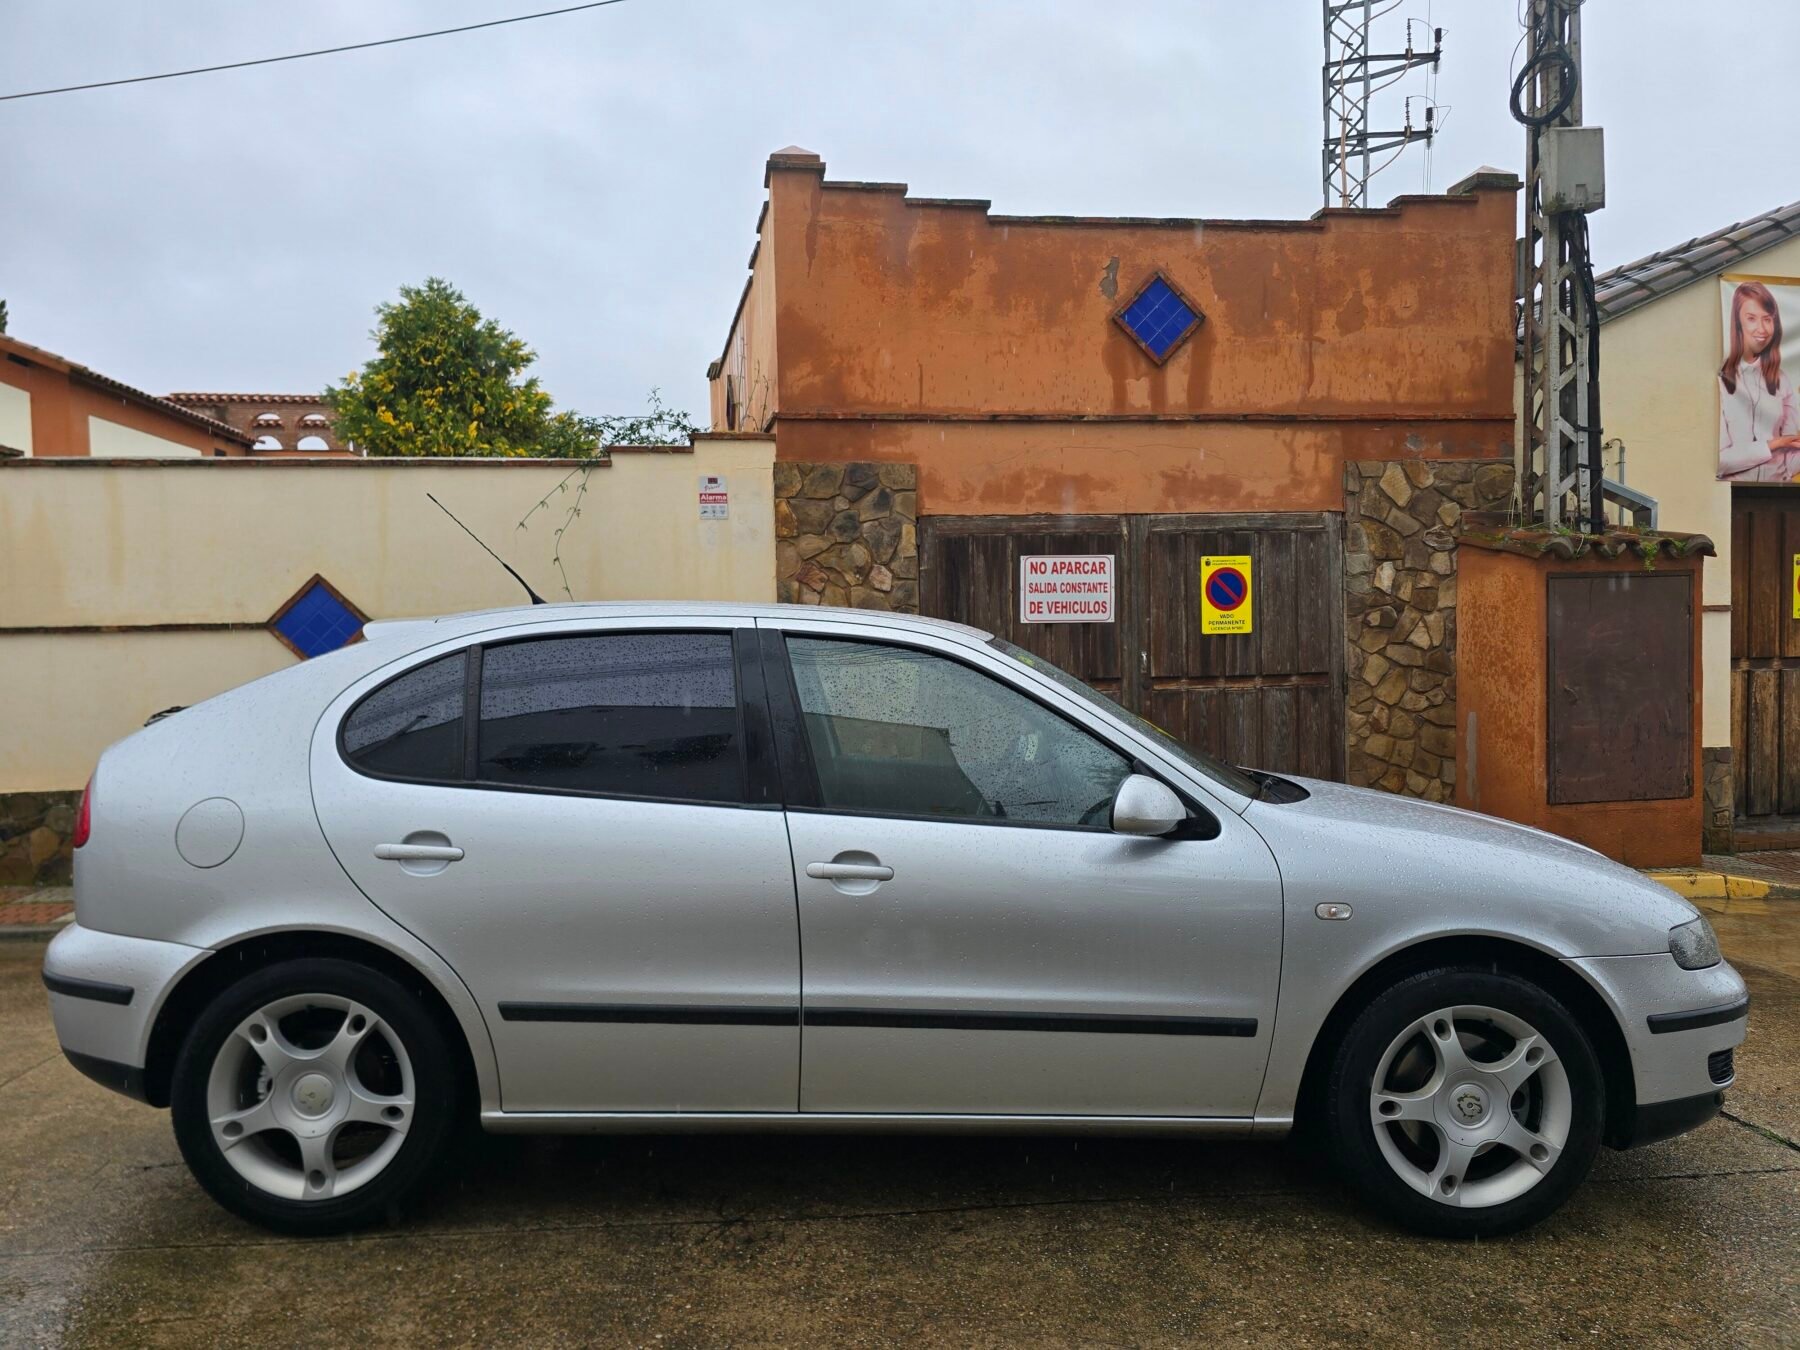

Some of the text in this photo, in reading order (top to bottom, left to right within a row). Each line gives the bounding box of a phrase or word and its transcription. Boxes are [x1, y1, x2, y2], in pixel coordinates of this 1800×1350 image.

[1029, 561, 1106, 574] NO APARCAR
[1028, 582, 1108, 593] SALIDA CONSTANTE
[1029, 601, 1107, 614] DE VEHICULOS
